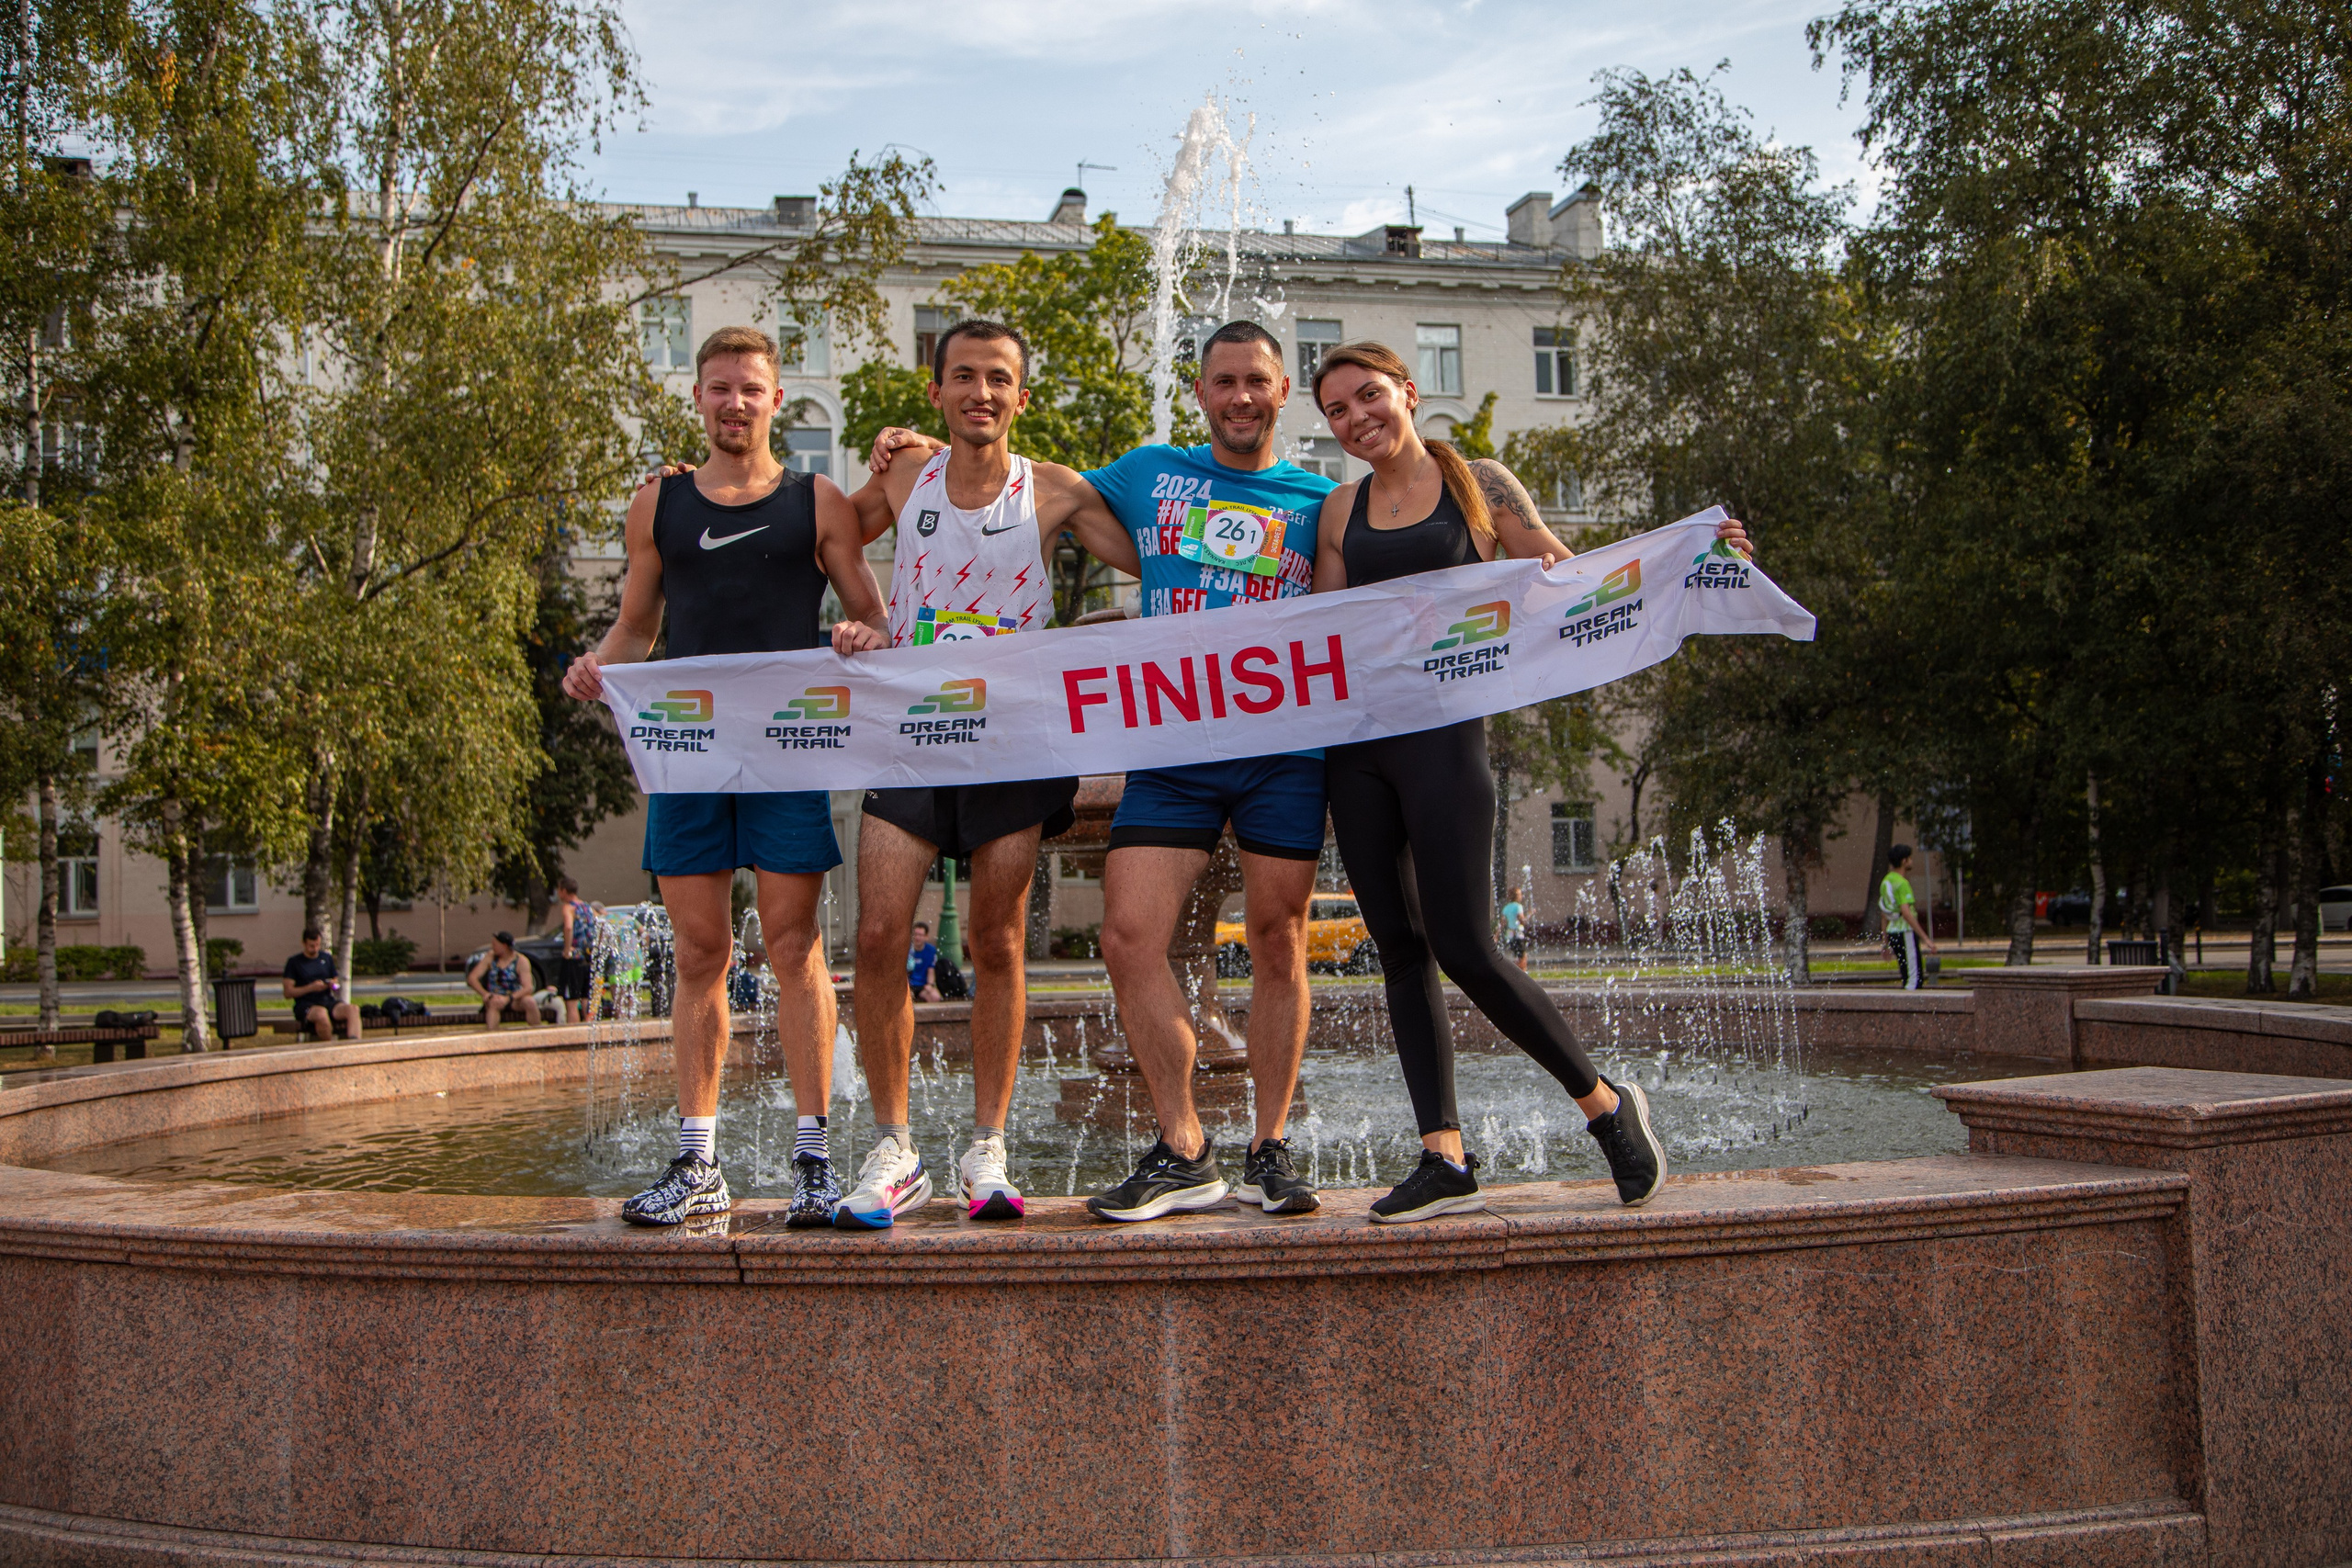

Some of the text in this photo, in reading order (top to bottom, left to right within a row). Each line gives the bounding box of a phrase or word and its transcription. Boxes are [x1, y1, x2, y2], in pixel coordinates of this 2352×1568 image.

[1151, 472, 1213, 500] 2024
[1210, 506, 1228, 517] DREAM
[1216, 517, 1245, 541] 26
[1250, 530, 1257, 544] 1
[1271, 525, 1283, 553] ЭСТАФЕТА
[1204, 548, 1226, 564] KANNAS
[1236, 558, 1250, 567] ЛЕС
[936, 618, 956, 632] DREAM
[1559, 598, 1643, 639] DREAM
[1572, 617, 1638, 649] TRAIL
[1423, 642, 1510, 672] DREAM
[1435, 660, 1505, 682] TRAIL
[1062, 634, 1349, 734] FINISH
[630, 727, 715, 740] DREAM
[765, 725, 851, 739] DREAM
[899, 717, 986, 735] DREAM
[641, 739, 708, 752] TRAIL
[777, 737, 845, 750] TRAIL
[911, 731, 979, 747] TRAIL
